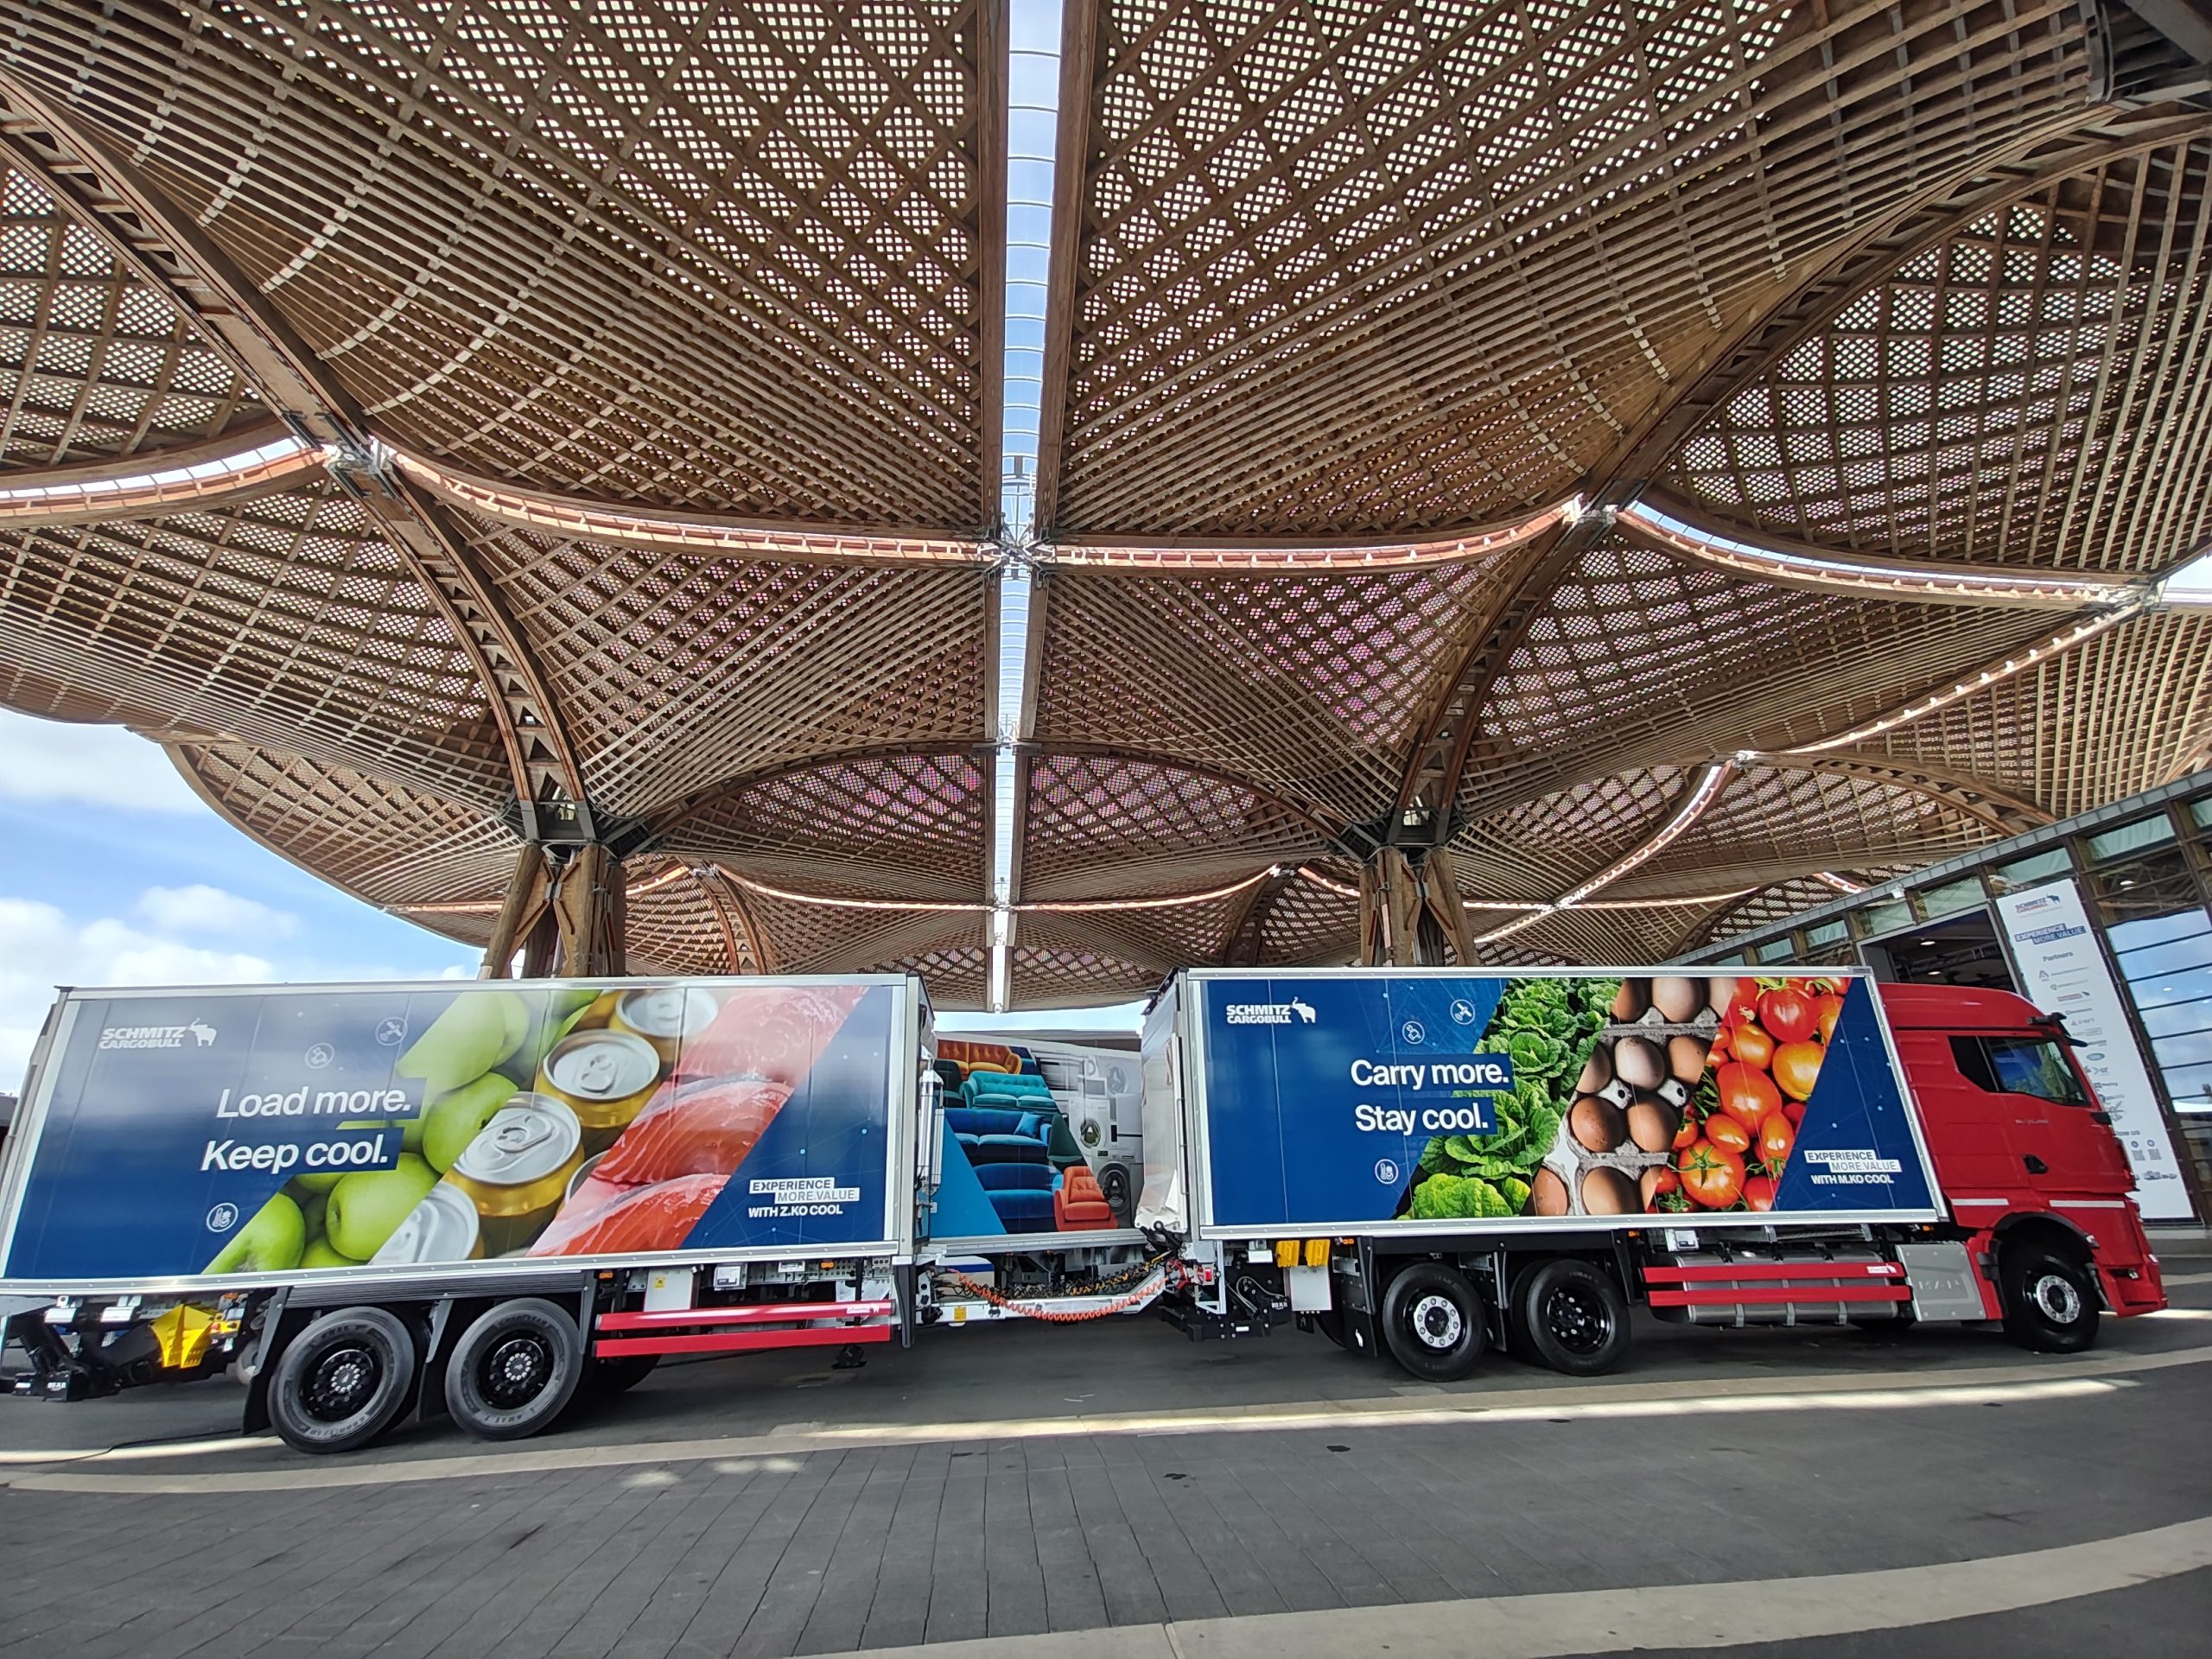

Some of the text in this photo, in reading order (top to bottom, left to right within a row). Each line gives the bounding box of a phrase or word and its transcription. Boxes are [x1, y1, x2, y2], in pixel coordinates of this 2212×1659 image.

[2016, 924, 2065, 941] EXPERIENCE
[2043, 951, 2074, 963] Partners
[1226, 1004, 1291, 1015] SCHMITZ
[1227, 1015, 1292, 1024] CARGOBULL
[102, 1026, 188, 1040] SCHMITZ
[99, 1038, 182, 1050] CARGOBULL
[1351, 1059, 1510, 1090] Carry more.
[216, 1086, 412, 1118] Load more.
[1355, 1103, 1489, 1136] Stay cool.
[200, 1134, 389, 1175] Keep cool.
[1808, 1151, 1873, 1161] EXPERIENCE
[752, 1179, 832, 1192] EXPERIENCE
[1810, 1173, 1895, 1185] WITH M.KO COOL
[747, 1204, 844, 1218] WITH Z.KO COOL
